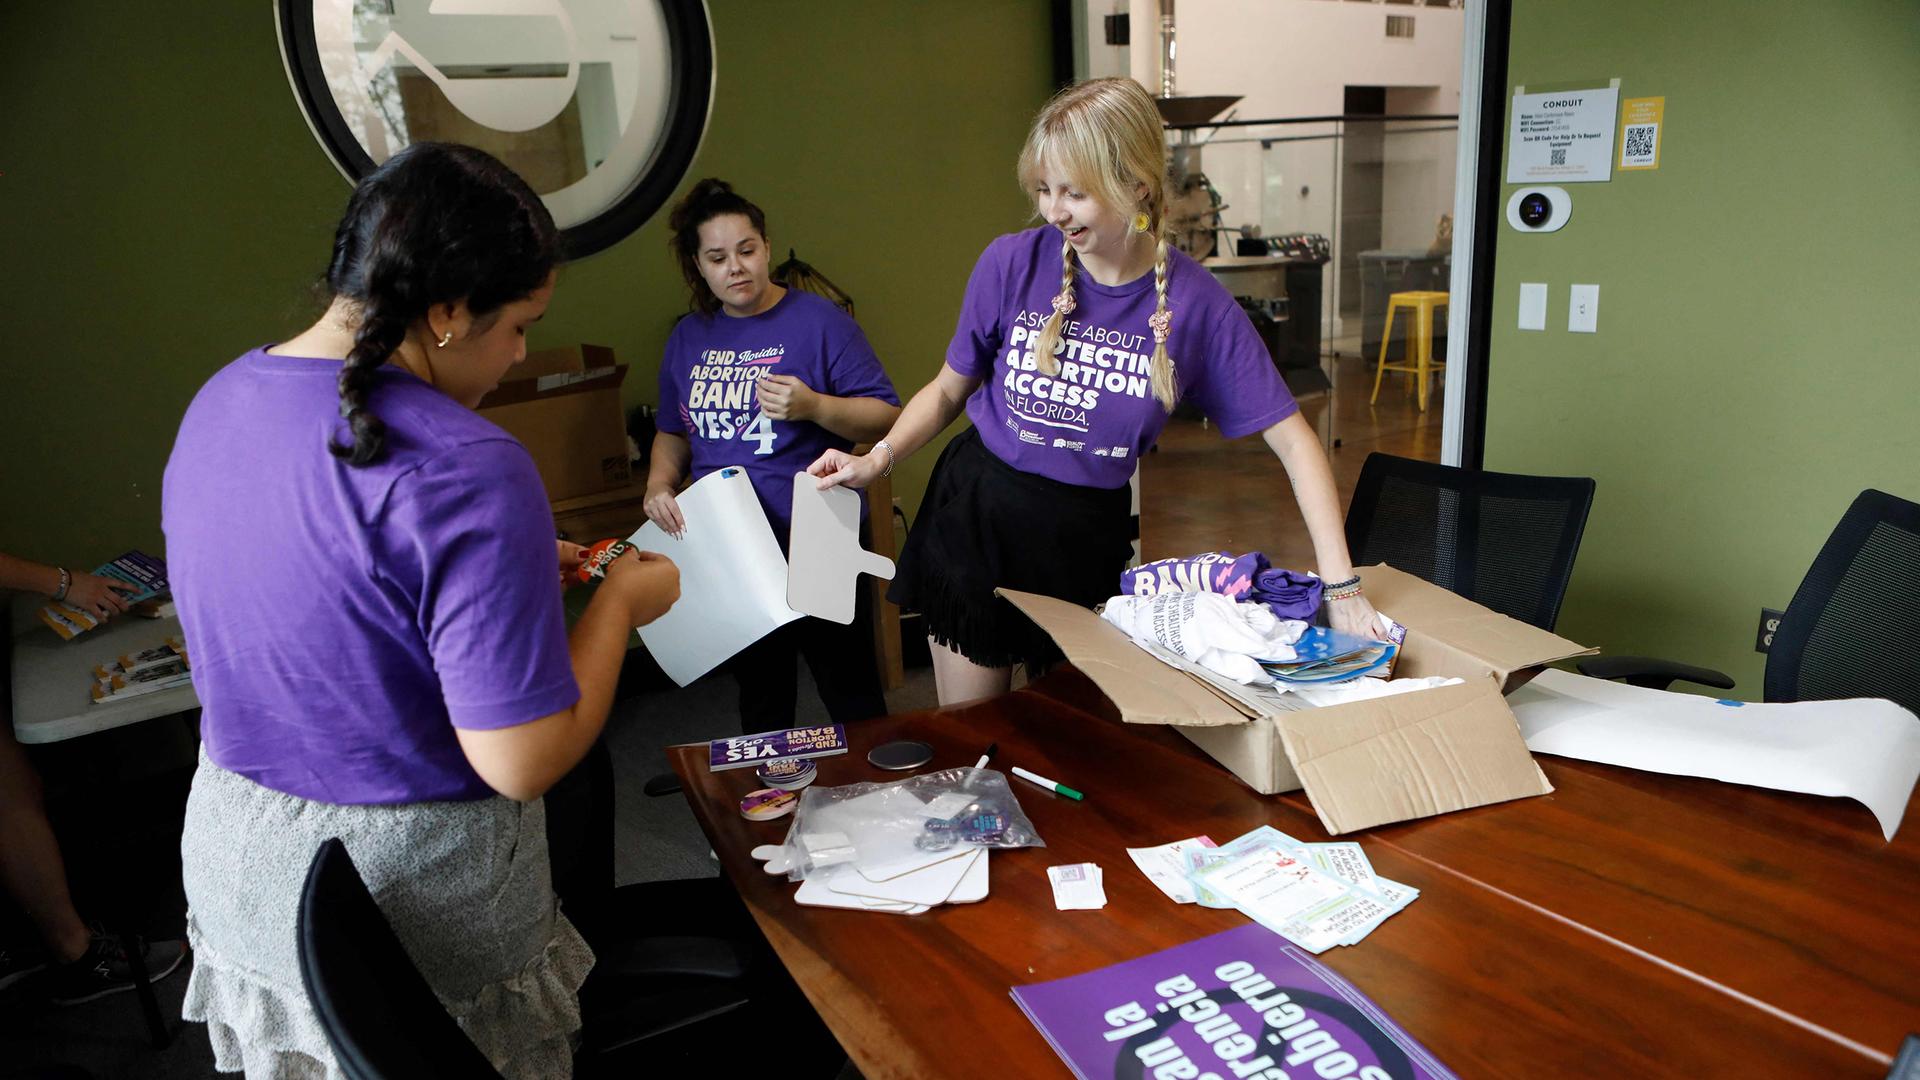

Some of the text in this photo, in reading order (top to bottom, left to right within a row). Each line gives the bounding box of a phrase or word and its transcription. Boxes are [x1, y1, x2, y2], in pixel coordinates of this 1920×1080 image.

[1542, 98, 1583, 109] CONDUIT
[1015, 310, 1146, 351] ASK ME ABOUT
[706, 344, 785, 366] END Florida's
[689, 365, 771, 382] ABORTION
[1006, 349, 1148, 399] ABRTION
[688, 381, 752, 410] BAN!
[1004, 369, 1100, 410] ACCESS
[1016, 395, 1090, 426] FLORIDA.
[689, 408, 778, 455] YES ON 4
[726, 738, 763, 749] ON 4
[786, 727, 835, 739] BAN!
[788, 733, 837, 745] ABORTION
[726, 744, 779, 762] YES
[815, 740, 837, 749] END
[1103, 1000, 1158, 1043] la
